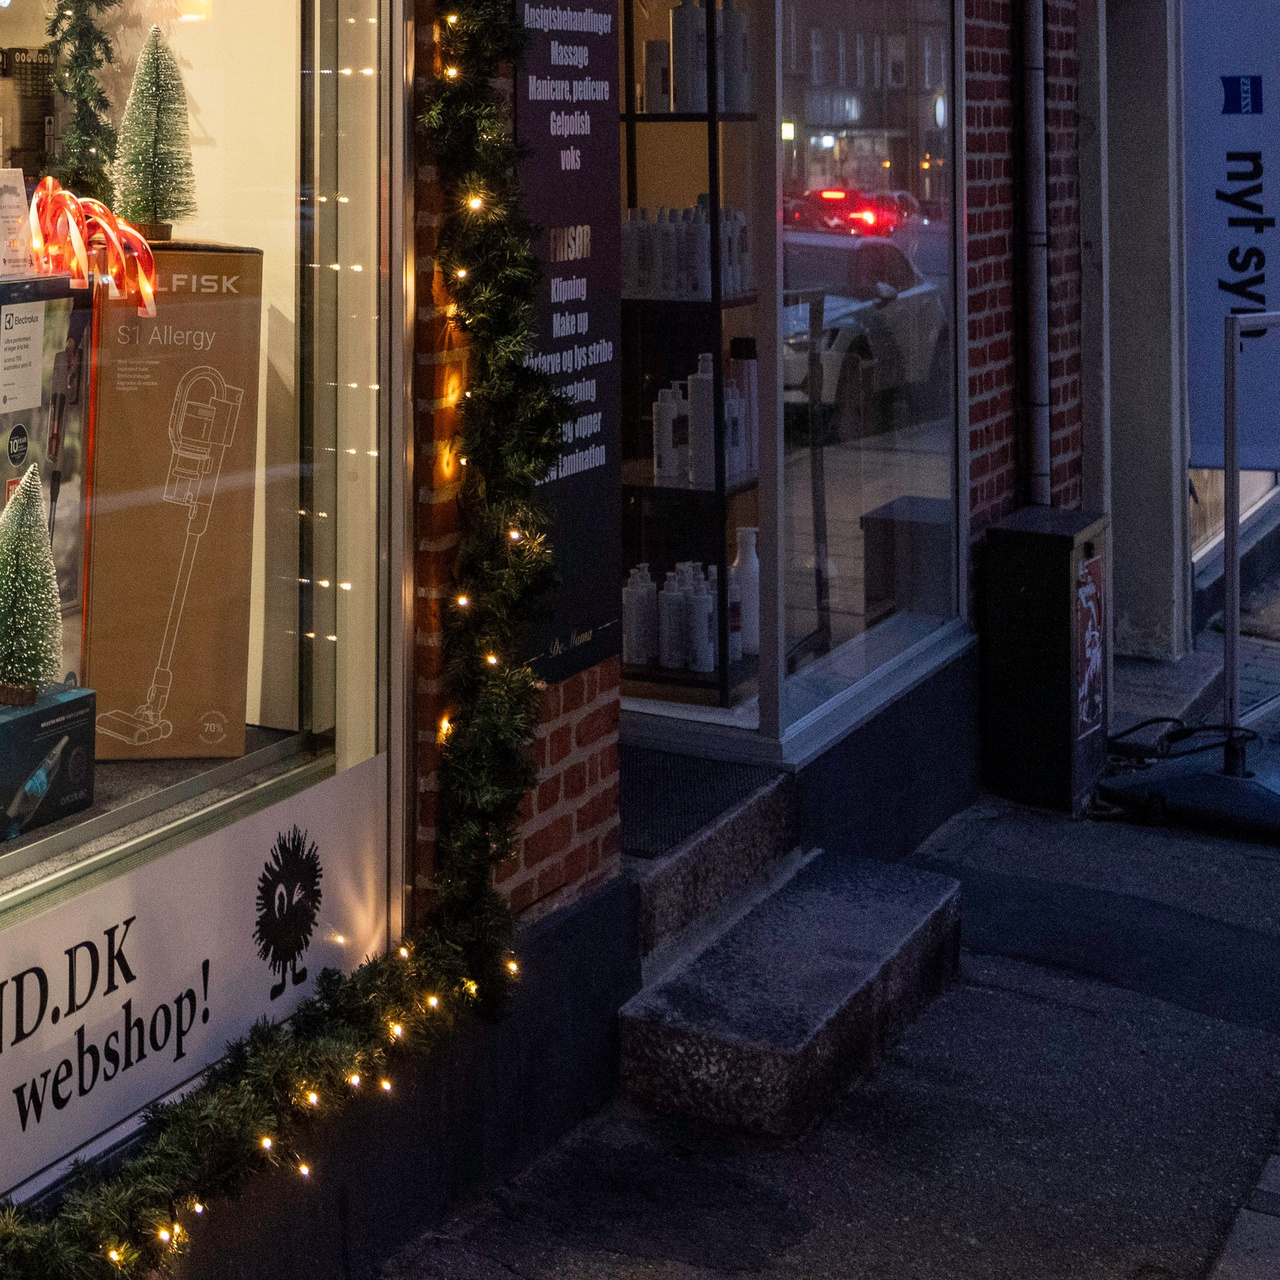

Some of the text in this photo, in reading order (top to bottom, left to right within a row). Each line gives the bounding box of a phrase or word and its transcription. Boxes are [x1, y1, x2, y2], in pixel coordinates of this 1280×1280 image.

[524, 3, 612, 36] Ansigtsbehandlinger
[550, 40, 589, 69] Massage
[528, 76, 609, 103] Manicure, pedicure
[1240, 77, 1252, 114] ZEISS
[550, 111, 591, 137] Gelpolish
[560, 145, 581, 170] voks
[1215, 151, 1276, 233] nyt
[550, 276, 587, 304] Klipning
[14, 314, 39, 326] Electrolux
[552, 312, 589, 338] Make up
[117, 325, 216, 351] S1 Allergy
[562, 350, 573, 373] og
[574, 344, 587, 371] lys
[588, 339, 613, 366] stribe
[10, 439, 18, 454] 10
[558, 444, 606, 479] Lamination
[203, 722, 223, 733] 70%
[12, 958, 212, 1134] webshop!
